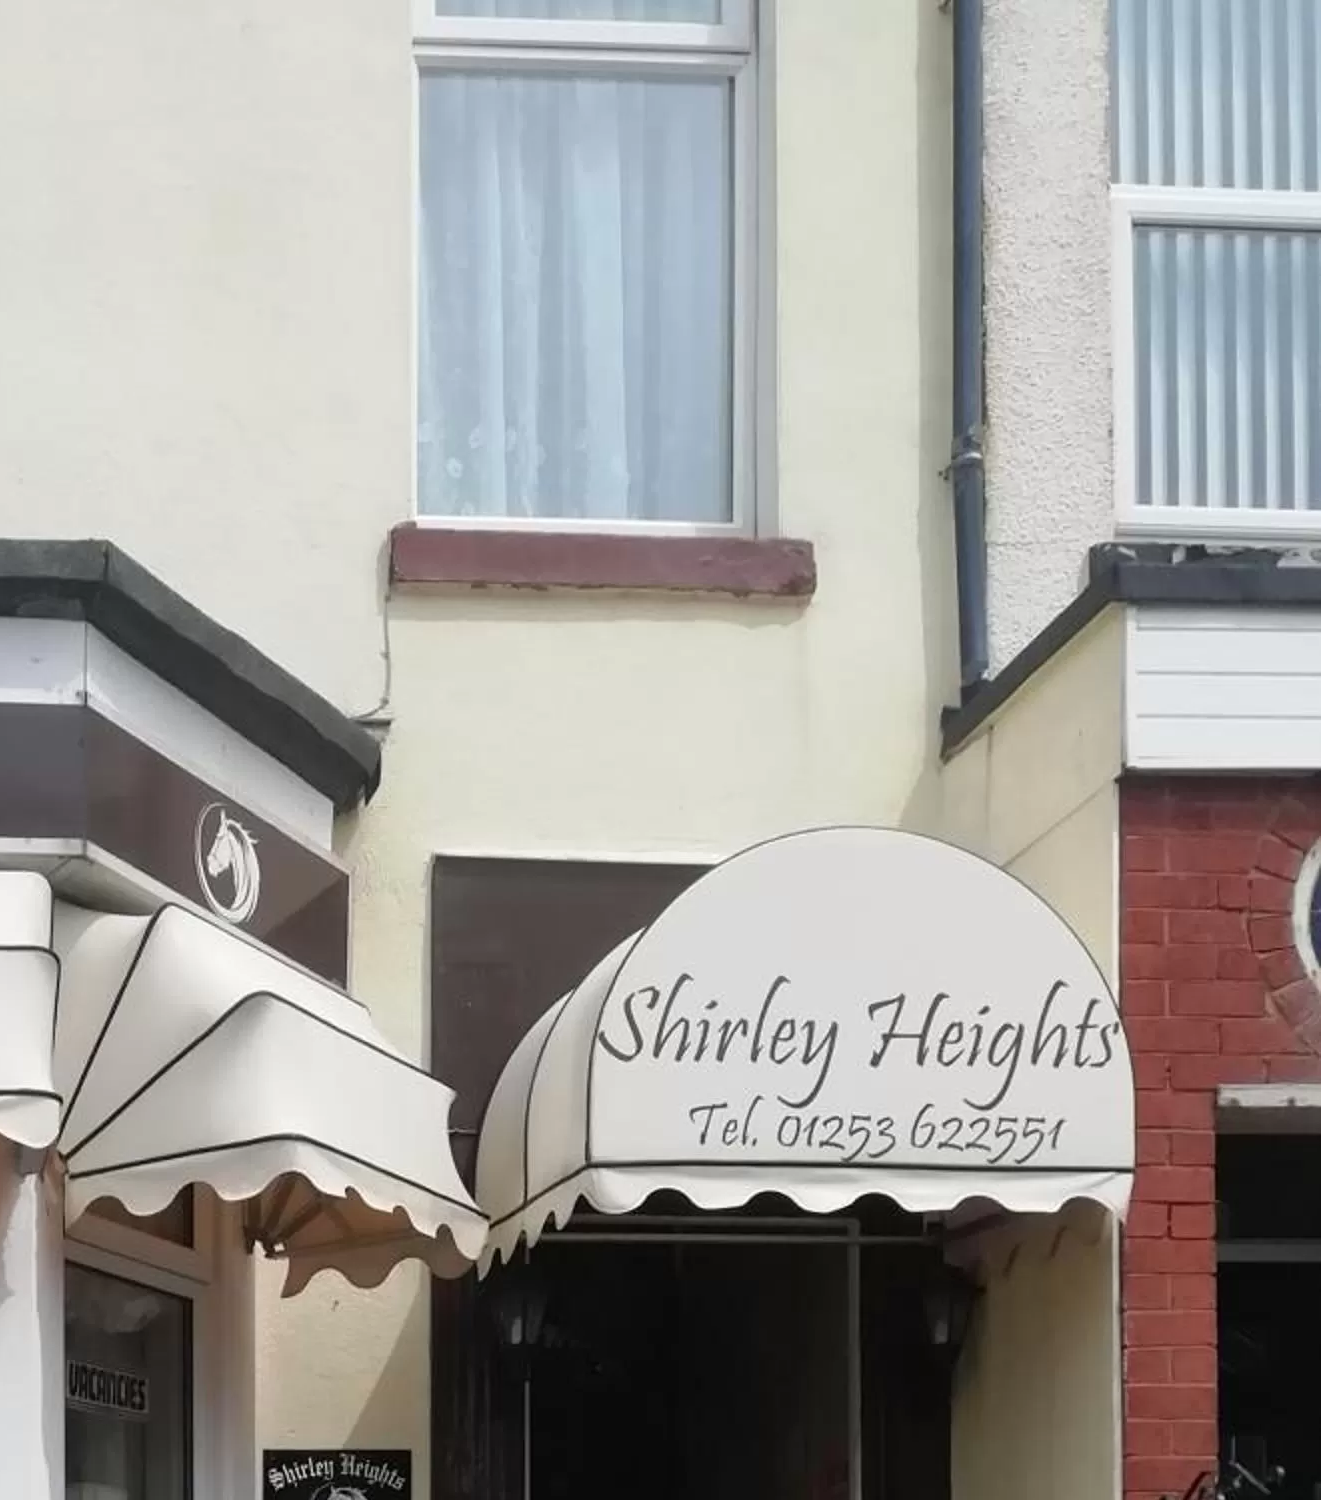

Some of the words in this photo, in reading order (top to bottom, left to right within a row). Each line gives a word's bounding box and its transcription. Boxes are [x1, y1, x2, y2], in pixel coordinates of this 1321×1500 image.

[597, 972, 839, 1109] Shirley
[866, 979, 1120, 1111] Heights
[688, 1095, 759, 1148] Tel.
[776, 1113, 897, 1163] 01253
[910, 1102, 1068, 1164] 622551
[69, 1363, 146, 1411] VACANCIES
[268, 1457, 334, 1492] Shirley
[339, 1453, 407, 1491] Heights
